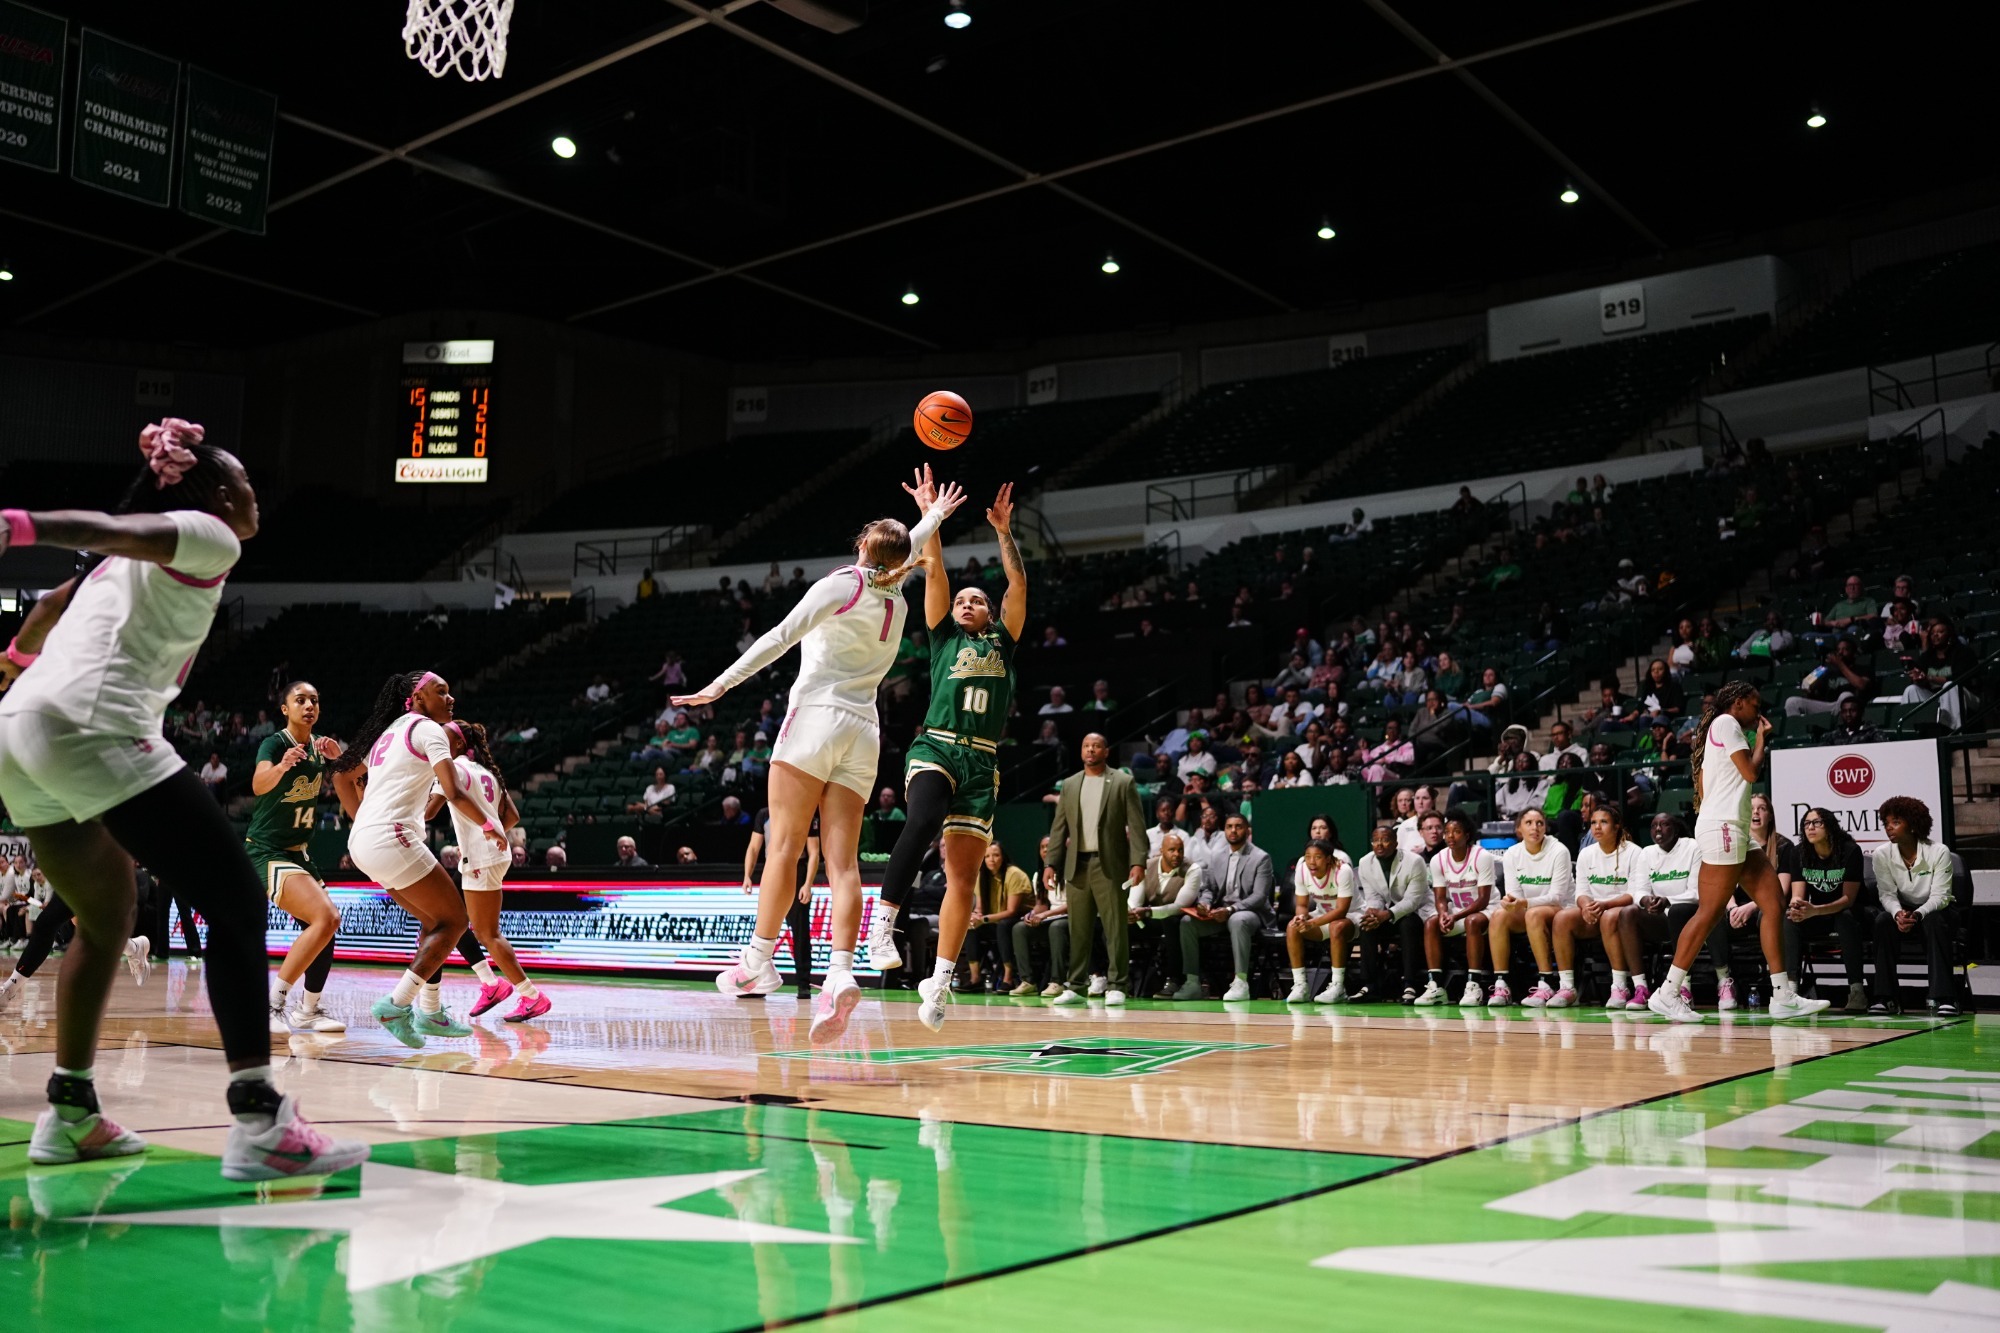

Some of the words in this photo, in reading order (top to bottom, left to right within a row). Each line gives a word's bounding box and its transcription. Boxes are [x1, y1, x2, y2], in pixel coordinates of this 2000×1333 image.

[85, 100, 168, 138] TOURNAMENT
[83, 118, 167, 155] CHAMPIONS
[194, 152, 219, 169] WEST
[219, 161, 260, 181] DIVISION
[217, 150, 237, 163] AND
[103, 160, 141, 184] 2021
[199, 165, 253, 190] CHAMPIONS
[206, 192, 242, 215] 2022
[1604, 298, 1641, 319] 219
[441, 347, 470, 359] Frost
[1332, 346, 1364, 362] 218
[139, 381, 171, 396] 215
[1030, 377, 1054, 393] 217
[410, 388, 425, 406] 15
[473, 388, 488, 405] 11
[736, 399, 766, 412] 216
[476, 404, 487, 422] 2
[413, 422, 424, 439] 2
[429, 425, 458, 436] STEALS
[476, 422, 486, 438] 4
[929, 427, 960, 446] ELITE
[412, 437, 423, 457] 0
[428, 442, 458, 453] BLOCKS
[474, 438, 486, 457] 0
[400, 462, 443, 478] Coors
[445, 468, 483, 478] LIGHT
[879, 598, 894, 642] 1
[949, 647, 1006, 678] Bulls
[962, 686, 989, 715] 10
[369, 733, 395, 768] 12
[1833, 767, 1870, 784] BWP
[481, 775, 495, 803] 3
[292, 807, 315, 829] 14
[1451, 892, 1474, 909] 15
[606, 913, 655, 940] MEAN
[656, 912, 708, 941] GREEN
